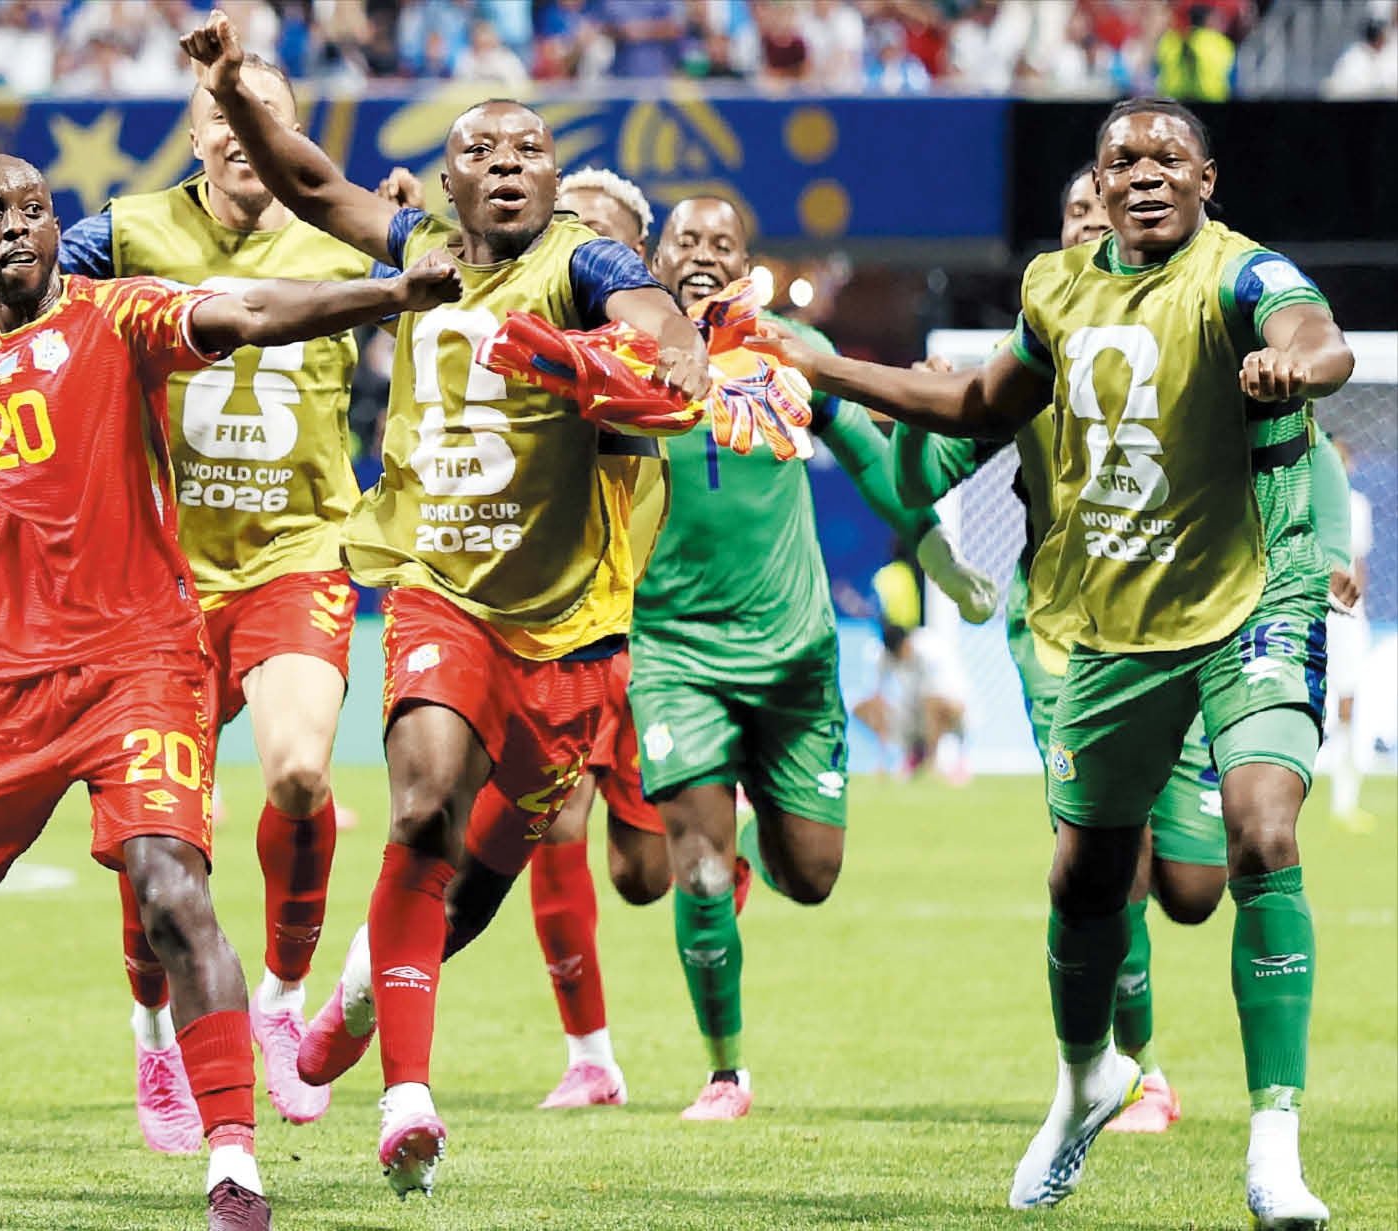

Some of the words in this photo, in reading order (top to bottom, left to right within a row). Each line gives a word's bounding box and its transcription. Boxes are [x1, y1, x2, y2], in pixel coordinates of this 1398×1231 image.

[215, 424, 267, 443] FIFA
[182, 461, 252, 482] WORLD
[255, 468, 293, 485] CUP
[435, 457, 484, 478] FIFA
[1096, 473, 1142, 495] FIFA
[179, 480, 289, 512] 2026
[478, 503, 520, 519] CUP
[415, 523, 522, 553] 2026
[1140, 519, 1176, 535] CUP
[1085, 531, 1176, 563] 2026
[122, 728, 201, 791] 20
